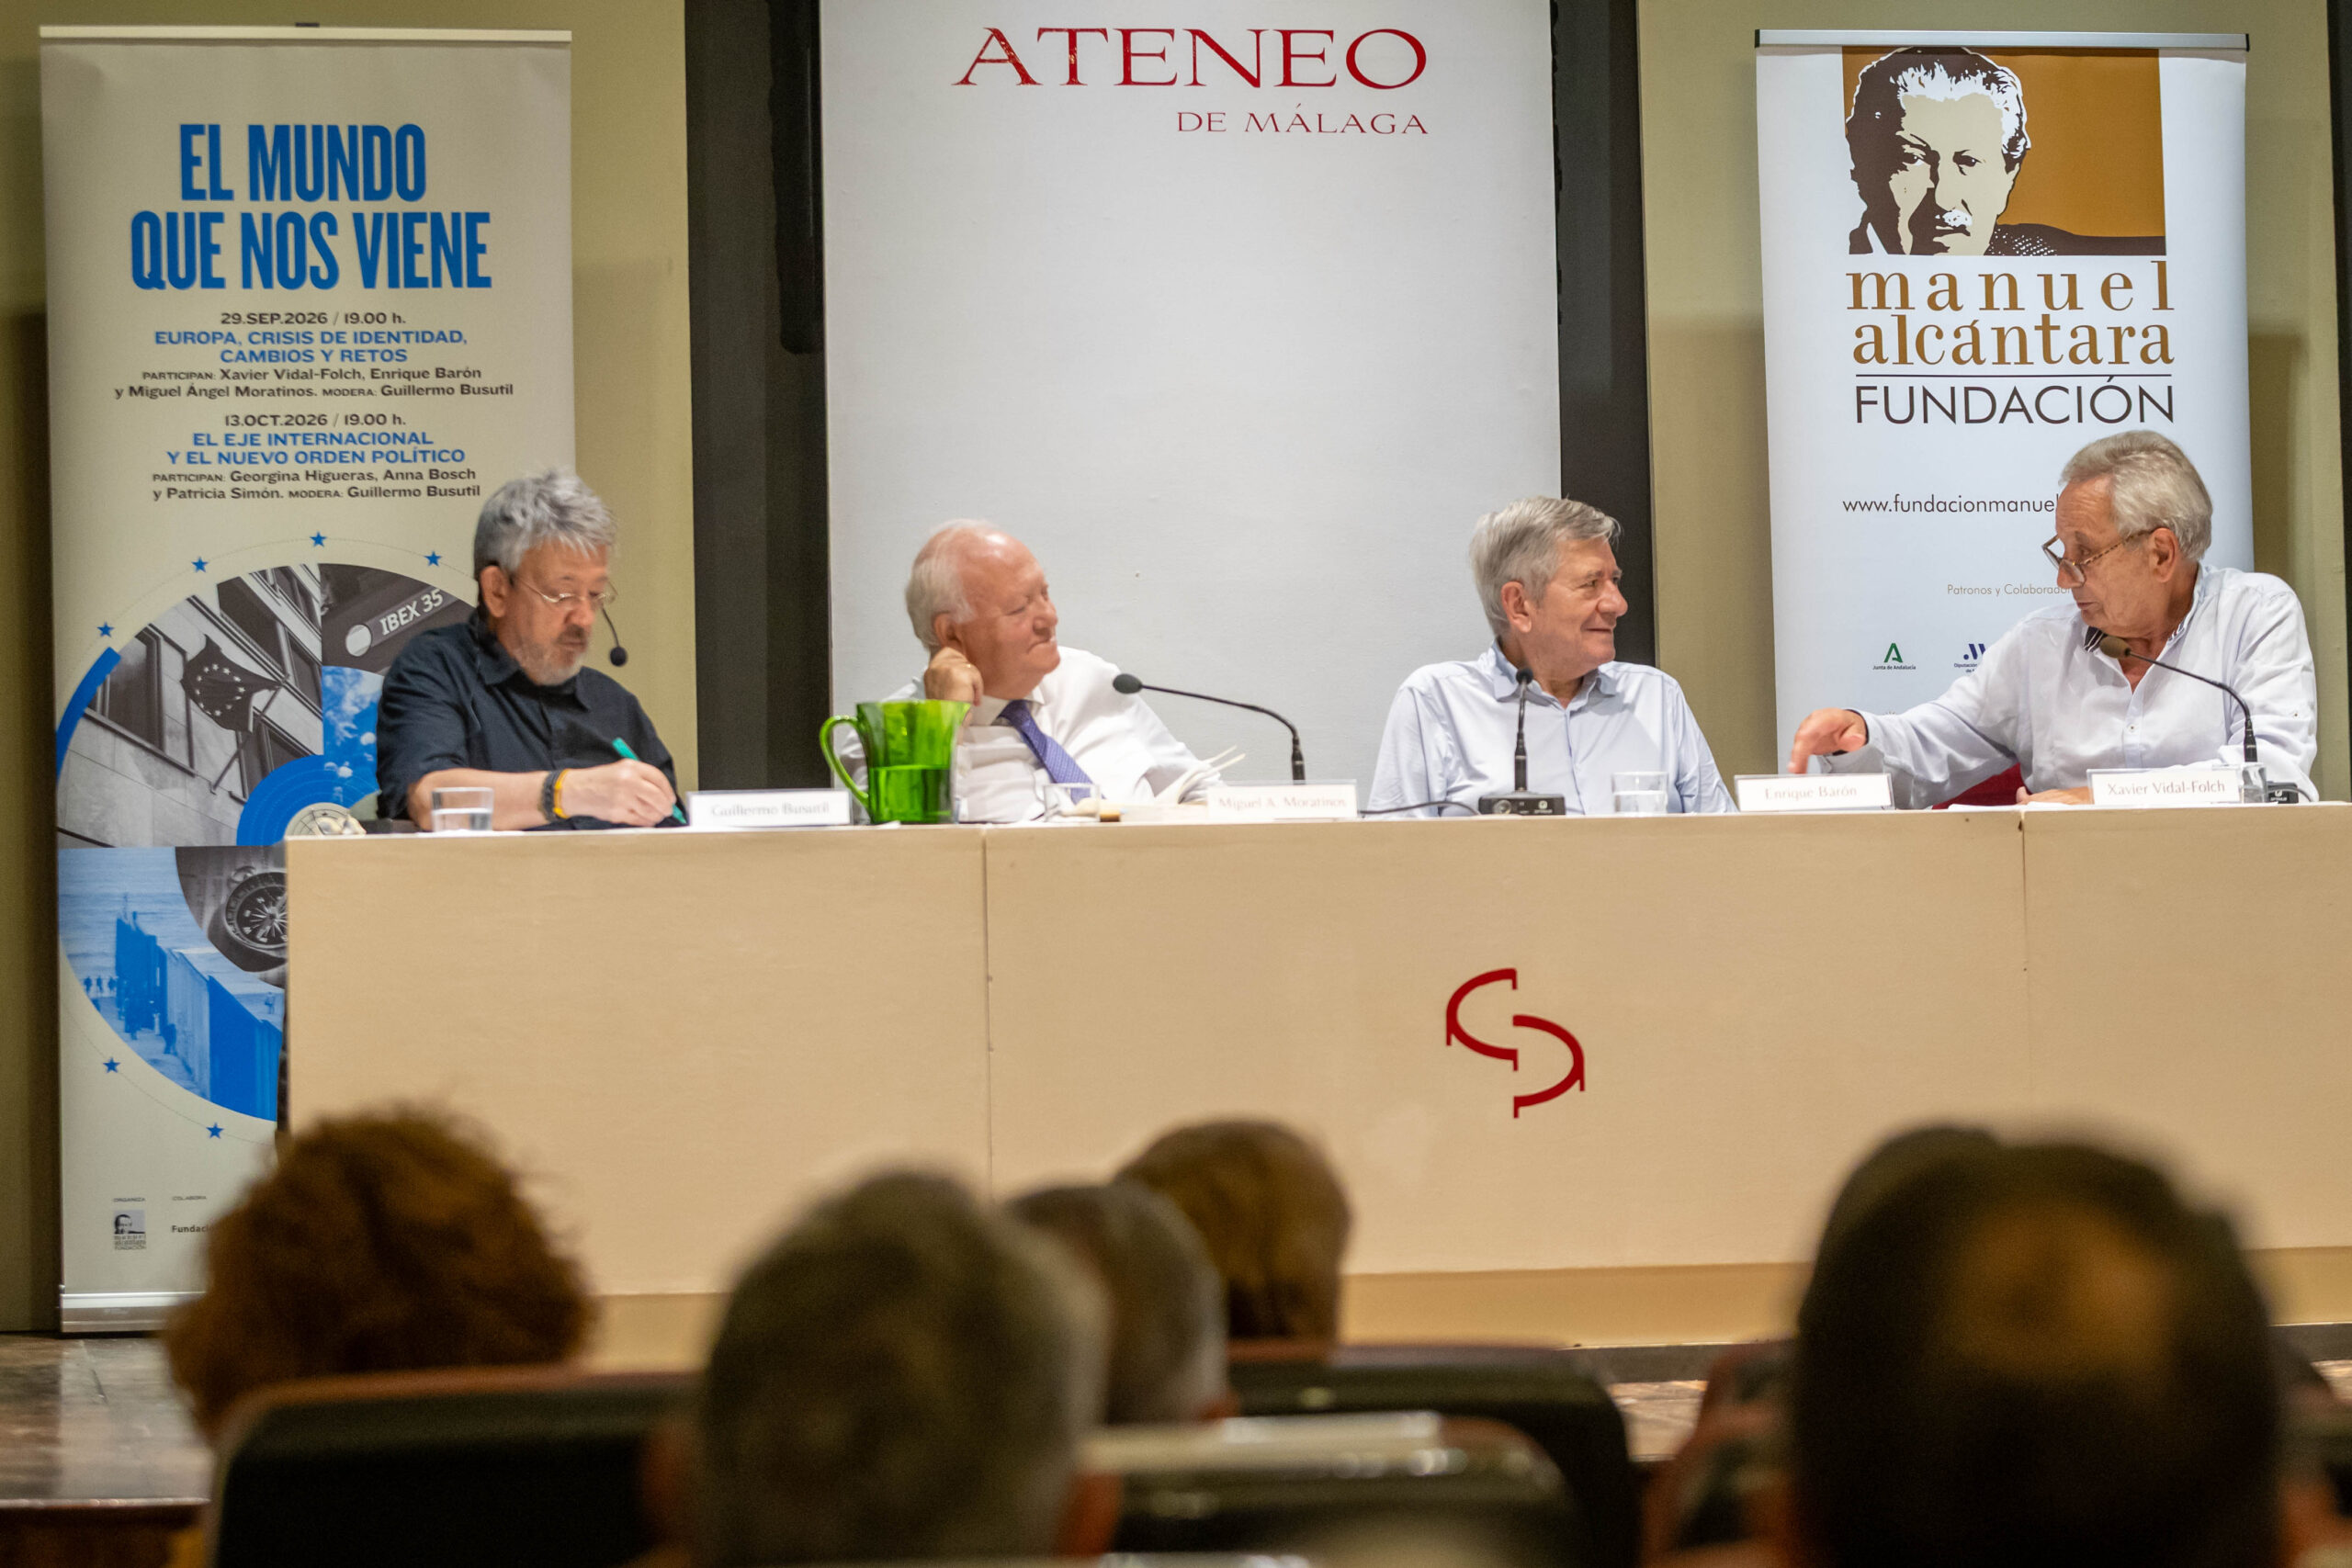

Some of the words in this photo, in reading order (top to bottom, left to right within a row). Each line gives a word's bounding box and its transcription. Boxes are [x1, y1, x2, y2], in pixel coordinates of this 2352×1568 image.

[951, 27, 1427, 90] ATENEO
[1177, 112, 1227, 133] DE
[1244, 103, 1429, 135] MÁLAGA
[180, 124, 234, 201] EL
[248, 123, 426, 202] MUNDO
[130, 210, 226, 290] QUE
[241, 210, 340, 290] NOS
[352, 211, 492, 289] VIENE
[1845, 260, 2175, 311] manuel
[220, 312, 328, 325] 29.SEP.2026
[345, 312, 387, 324] 19.00
[392, 312, 406, 324] h.
[154, 331, 243, 346] EUROPA,
[247, 331, 314, 345] CRISIS
[320, 331, 350, 344] DE
[353, 330, 468, 345] IDENTIDAD,
[1852, 314, 2175, 366] alcántara
[220, 349, 315, 364] CAMBIOS
[320, 349, 334, 363] Y
[340, 349, 408, 363] RETOS
[142, 371, 217, 381] PARTICIPAN:
[220, 368, 269, 380] Xavier
[274, 368, 366, 382] Vidal-Folch,
[370, 367, 430, 382] Enrique
[435, 366, 482, 379] Barón
[114, 389, 124, 400] y
[129, 385, 182, 400] Miguel
[187, 382, 231, 400] Ángel
[234, 385, 318, 398] Moratinos.
[322, 388, 378, 397] MODERA:
[381, 384, 456, 397] Guillermo
[460, 383, 514, 396] Busutil
[1855, 374, 2175, 424] FUNDACIÓN
[225, 414, 328, 427] 13.OCT.2026
[345, 414, 387, 426] 19.00
[392, 413, 406, 426] h.
[193, 433, 219, 446] EL
[224, 433, 262, 446] EJE
[267, 432, 435, 446] INTERNACIONAL
[166, 451, 181, 465] Y
[187, 451, 212, 465] EL
[218, 451, 289, 465] NUEVO
[294, 450, 366, 465] ORDEN
[372, 446, 466, 464] POLÍTICO
[153, 473, 226, 482] PARTICIPAN:
[230, 469, 301, 484] Georgina
[305, 468, 379, 483] Higueras,
[383, 468, 424, 481] Anna
[428, 468, 476, 480] Bosch
[153, 489, 163, 502] y
[166, 487, 226, 500] Patricia
[230, 487, 284, 500] Simón.
[288, 490, 344, 499] MODERA:
[347, 485, 422, 498] Guillermo
[426, 484, 481, 497] Busutil
[1947, 583, 1993, 596] Patronos
[1995, 587, 2001, 597] y
[379, 600, 421, 636] IBEX
[421, 589, 444, 613] 35
[2108, 782, 2149, 795] Xavier
[2152, 779, 2225, 795] Vidal-Folch
